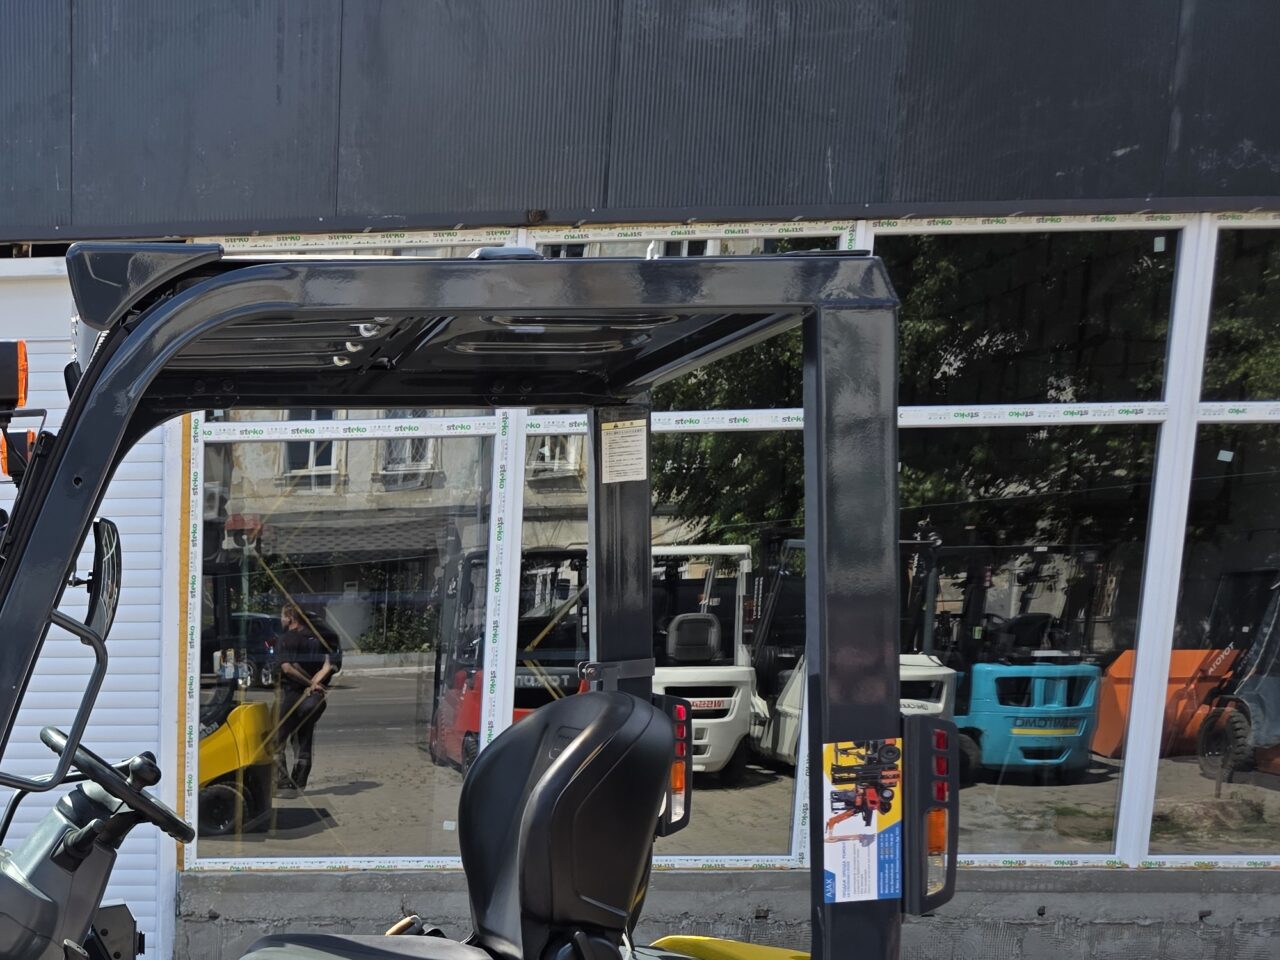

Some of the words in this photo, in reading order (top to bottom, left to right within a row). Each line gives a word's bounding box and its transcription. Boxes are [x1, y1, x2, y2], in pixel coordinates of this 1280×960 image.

[872, 220, 898, 228] steko
[981, 217, 1007, 225] steko
[1036, 216, 1062, 224] steko
[1145, 214, 1171, 222] steko
[564, 232, 590, 240] steko
[617, 230, 642, 238] steko
[670, 229, 696, 237] steko
[778, 225, 804, 233] steko
[954, 410, 979, 418] steko
[1008, 410, 1034, 418] steko
[1063, 409, 1089, 417] steko
[1118, 408, 1144, 416] steko
[501, 411, 509, 436] steko
[675, 416, 700, 425] steko
[239, 428, 264, 436] steko
[291, 426, 315, 435] steko
[342, 426, 367, 434] steko
[394, 424, 419, 432] steko
[446, 423, 471, 431] steko
[496, 517, 504, 541] steko
